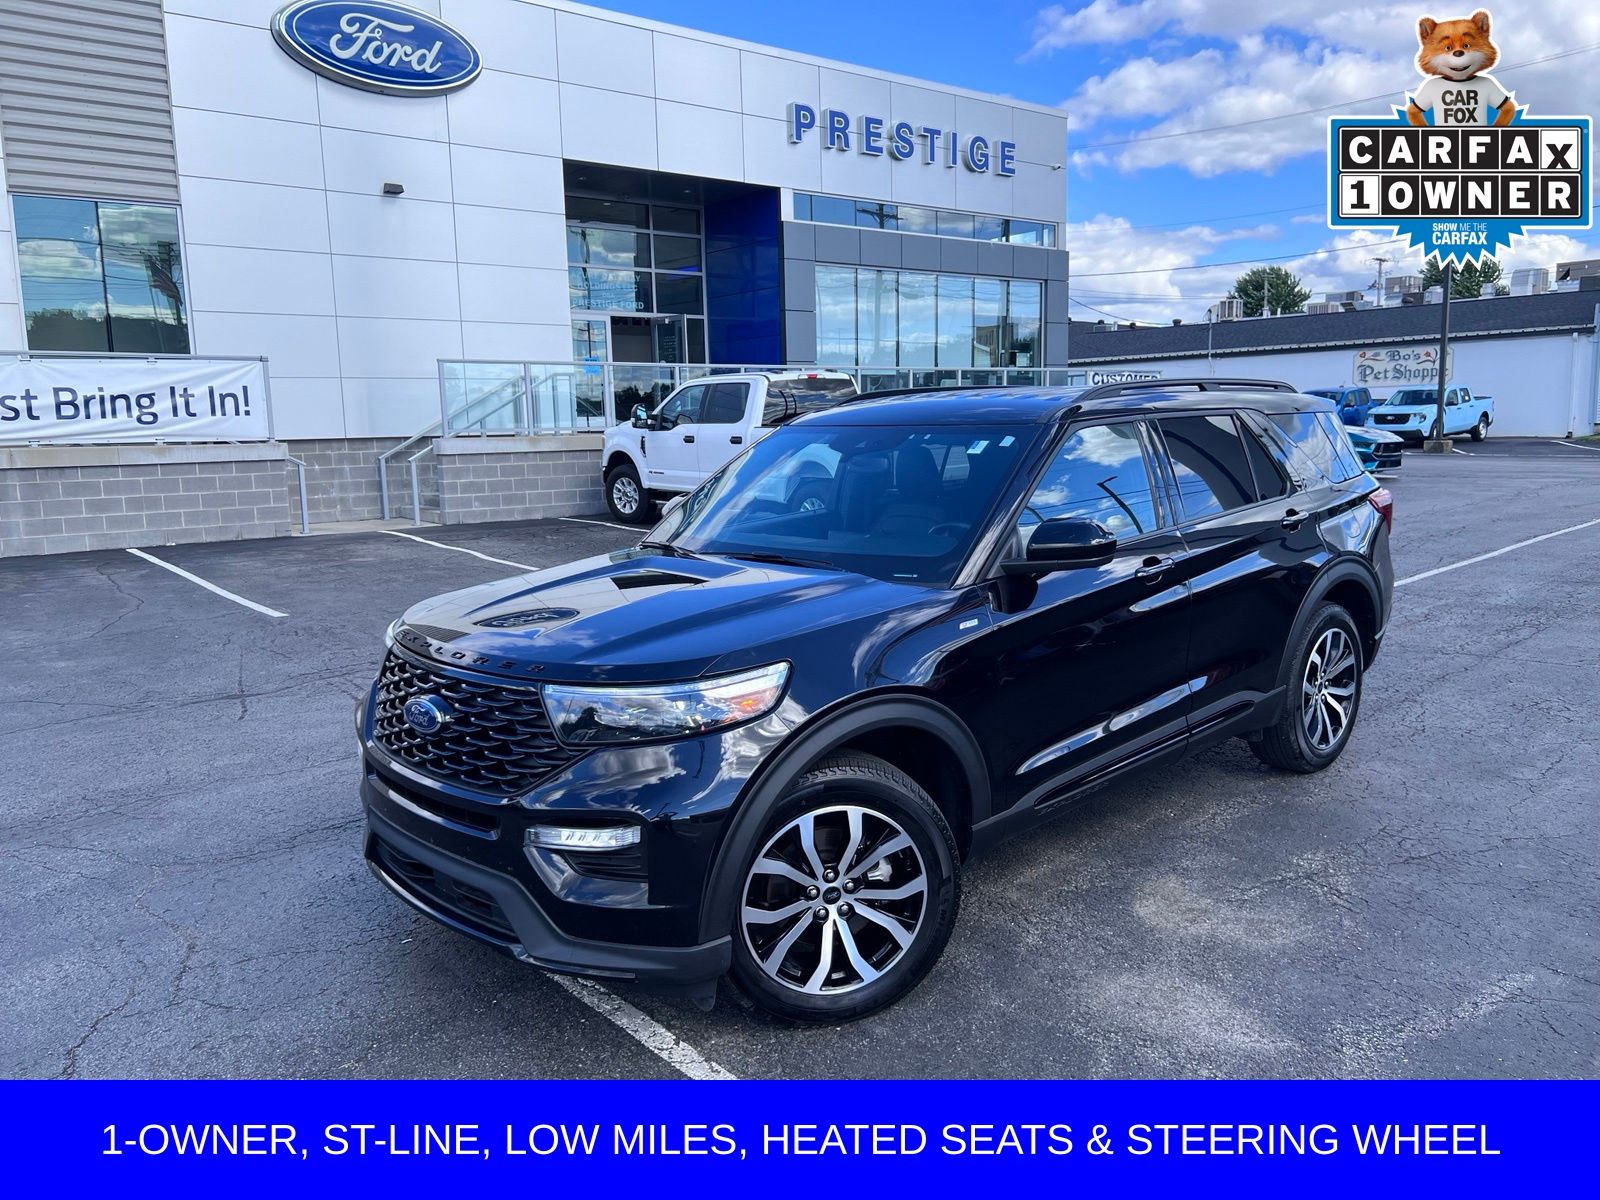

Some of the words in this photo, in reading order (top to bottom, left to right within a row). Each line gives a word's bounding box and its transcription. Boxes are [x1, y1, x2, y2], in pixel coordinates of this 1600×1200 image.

[329, 13, 443, 73] Ford
[790, 103, 1016, 175] PRESTIGE
[620, 301, 645, 310] FORD
[1385, 349, 1421, 361] Bo's
[1357, 364, 1389, 382] Pet
[1391, 363, 1448, 382] Shopp
[53, 387, 158, 425] Bring
[170, 386, 197, 417] It
[208, 385, 251, 416] In!
[409, 704, 431, 726] Ford
